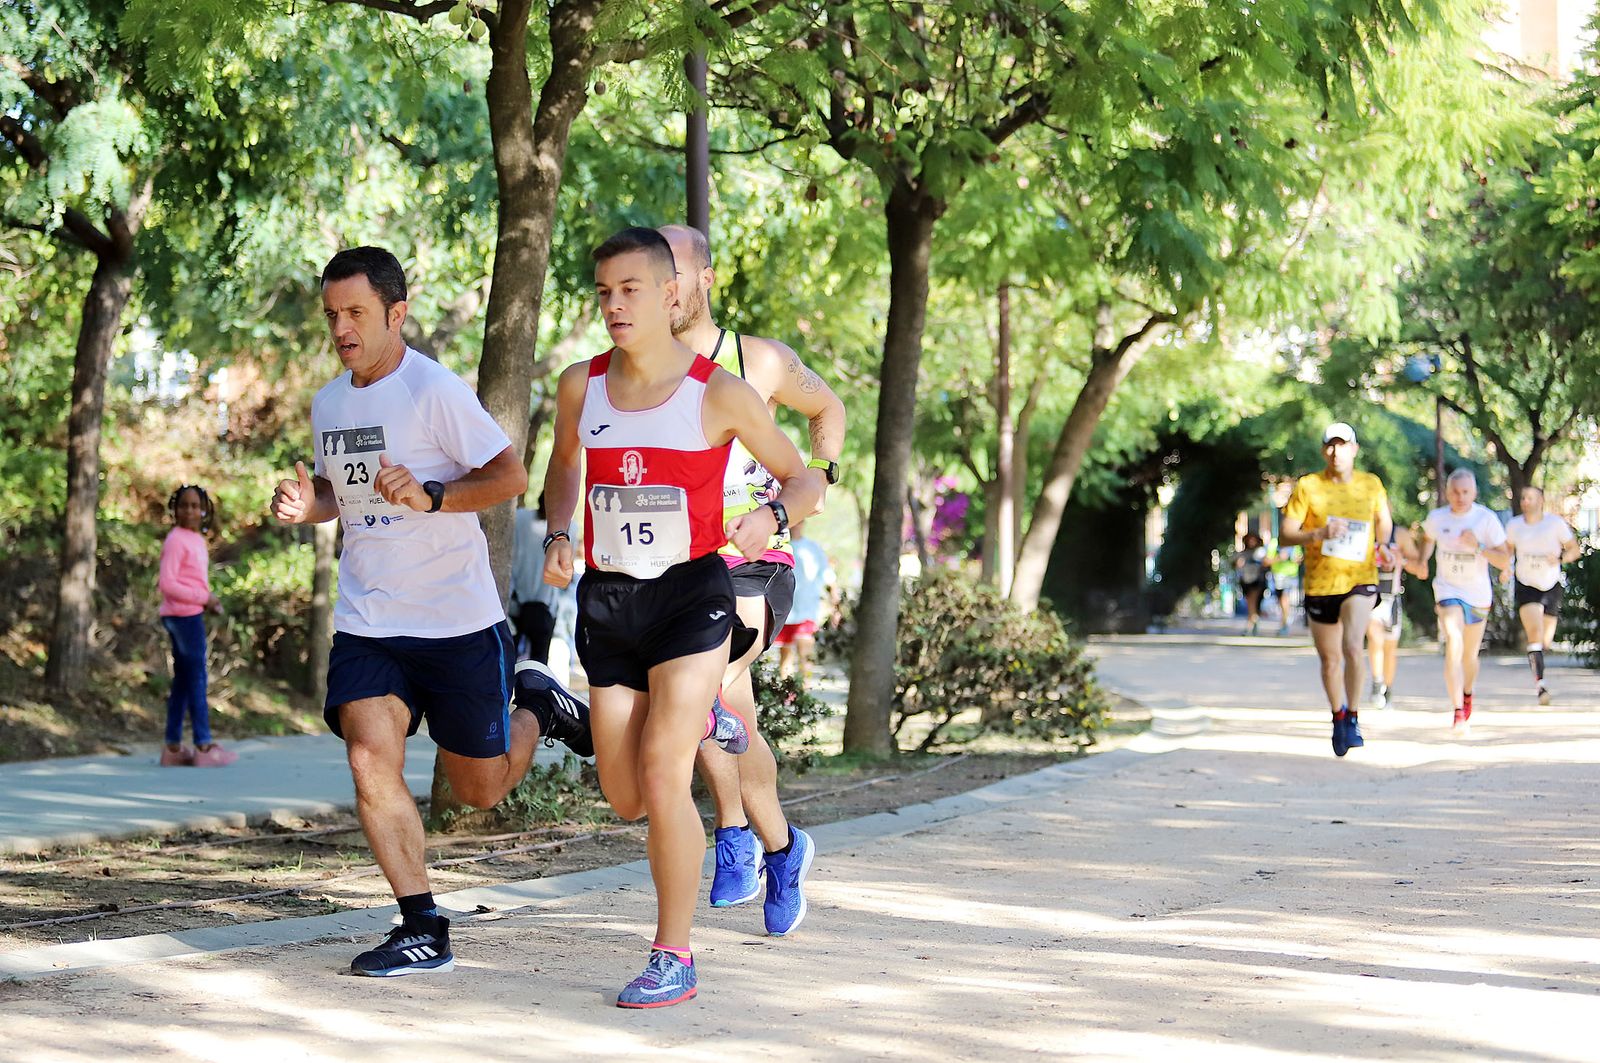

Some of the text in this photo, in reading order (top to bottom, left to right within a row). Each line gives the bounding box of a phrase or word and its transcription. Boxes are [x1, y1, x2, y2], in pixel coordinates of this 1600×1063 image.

[344, 462, 370, 486] 23
[723, 489, 737, 497] LVA
[369, 497, 385, 505] HUEL
[620, 522, 654, 545] 15
